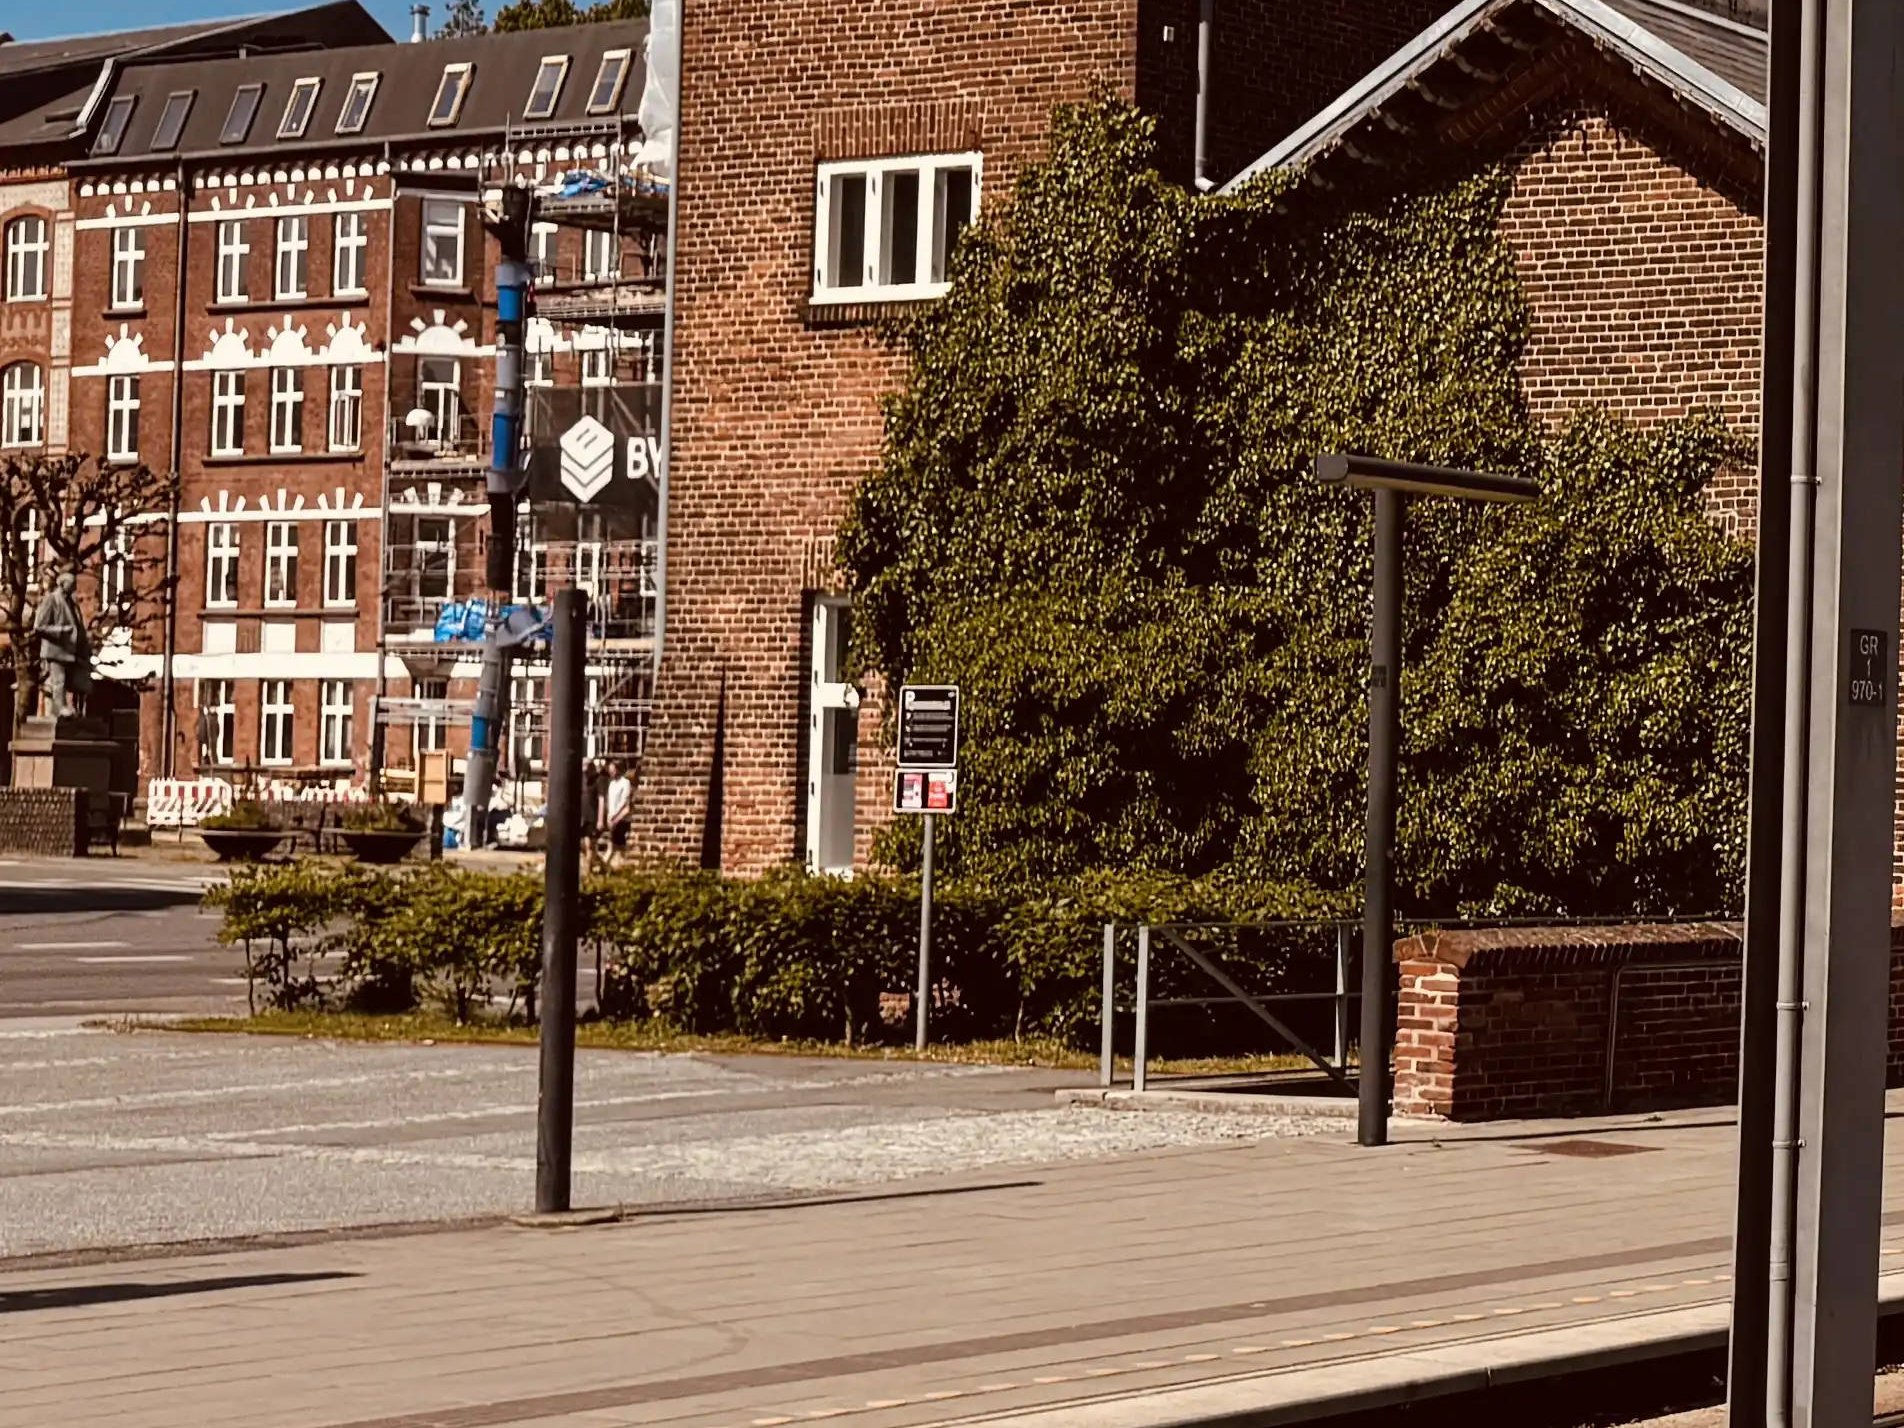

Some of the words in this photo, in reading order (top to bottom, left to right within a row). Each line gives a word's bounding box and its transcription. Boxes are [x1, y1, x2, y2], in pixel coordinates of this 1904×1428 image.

[1860, 634, 1879, 656] GR
[1866, 658, 1872, 679] 1
[1852, 680, 1883, 702] 970-1
